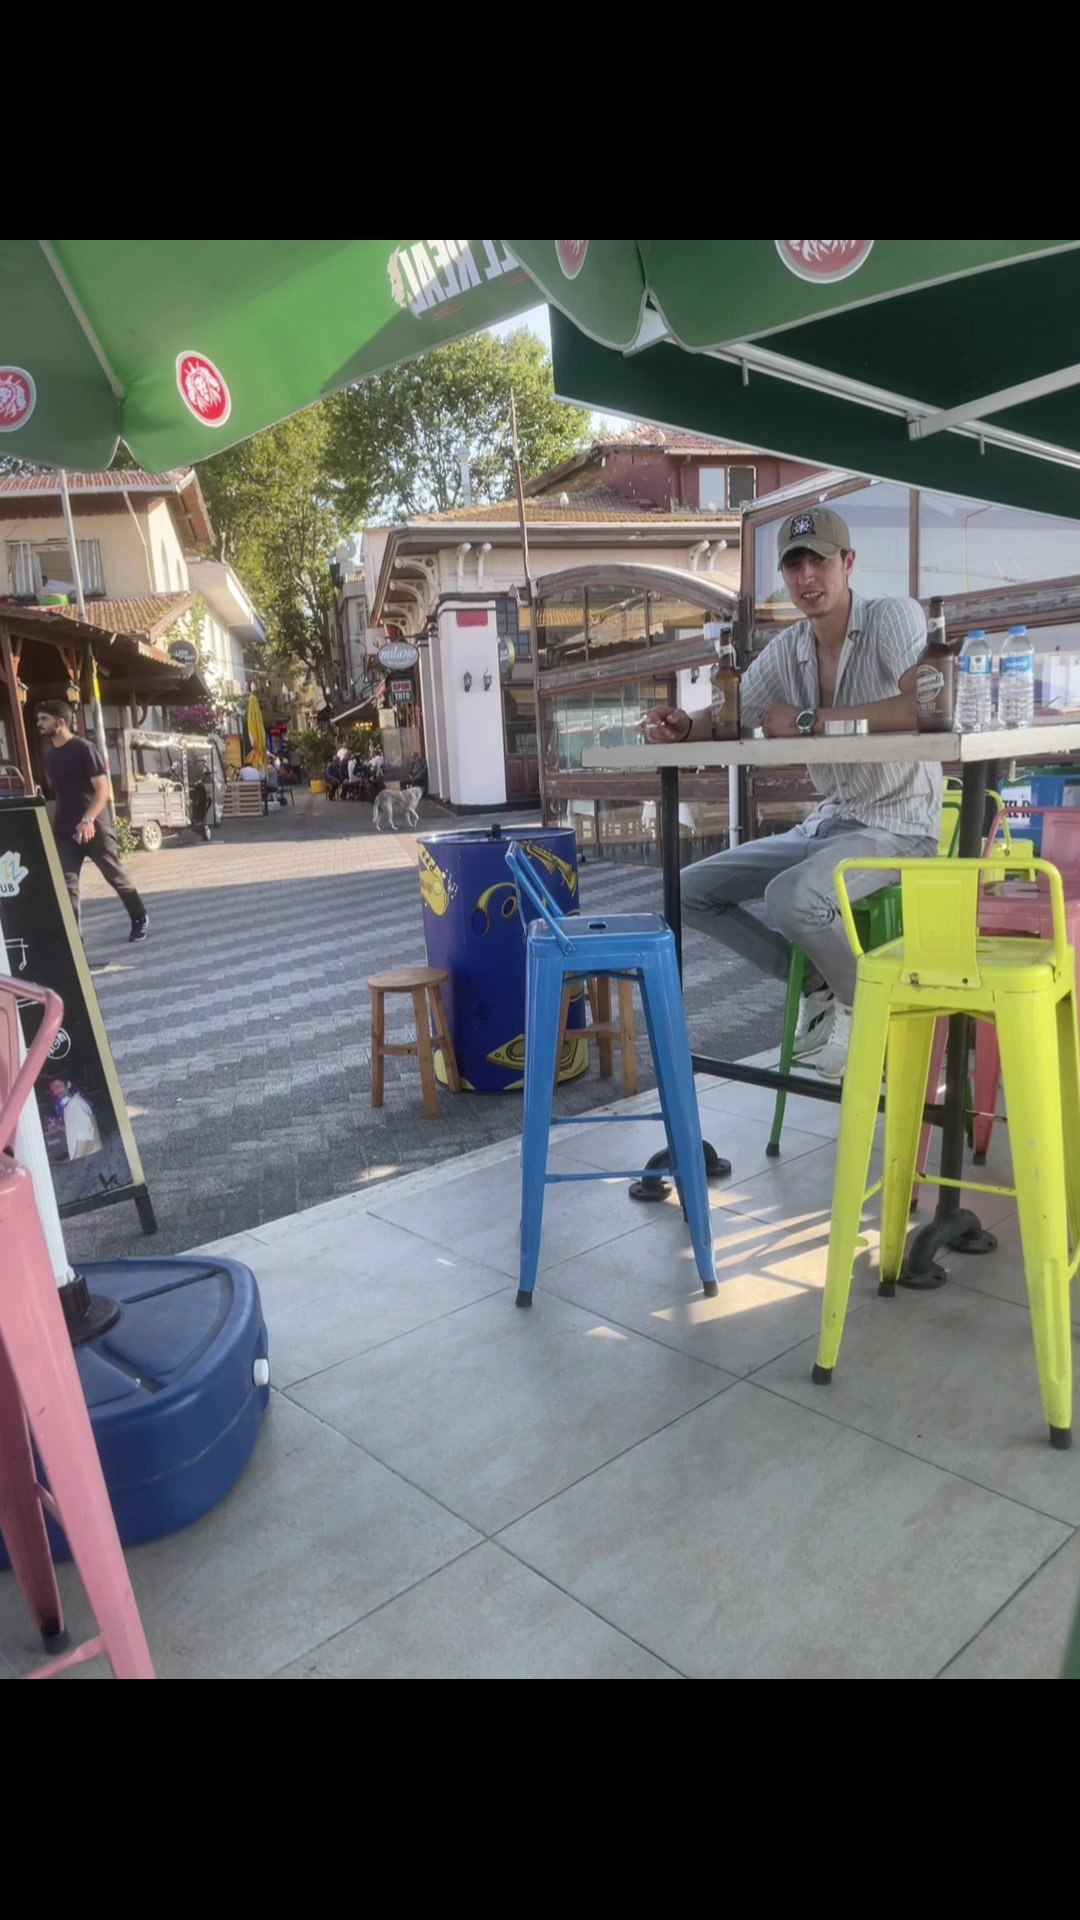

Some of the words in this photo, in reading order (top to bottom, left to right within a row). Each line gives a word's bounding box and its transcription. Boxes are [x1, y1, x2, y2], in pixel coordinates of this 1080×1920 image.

[380, 645, 416, 660] milano
[393, 682, 410, 691] SPOR
[393, 692, 411, 701] TOTO
[0, 883, 15, 894] UB
